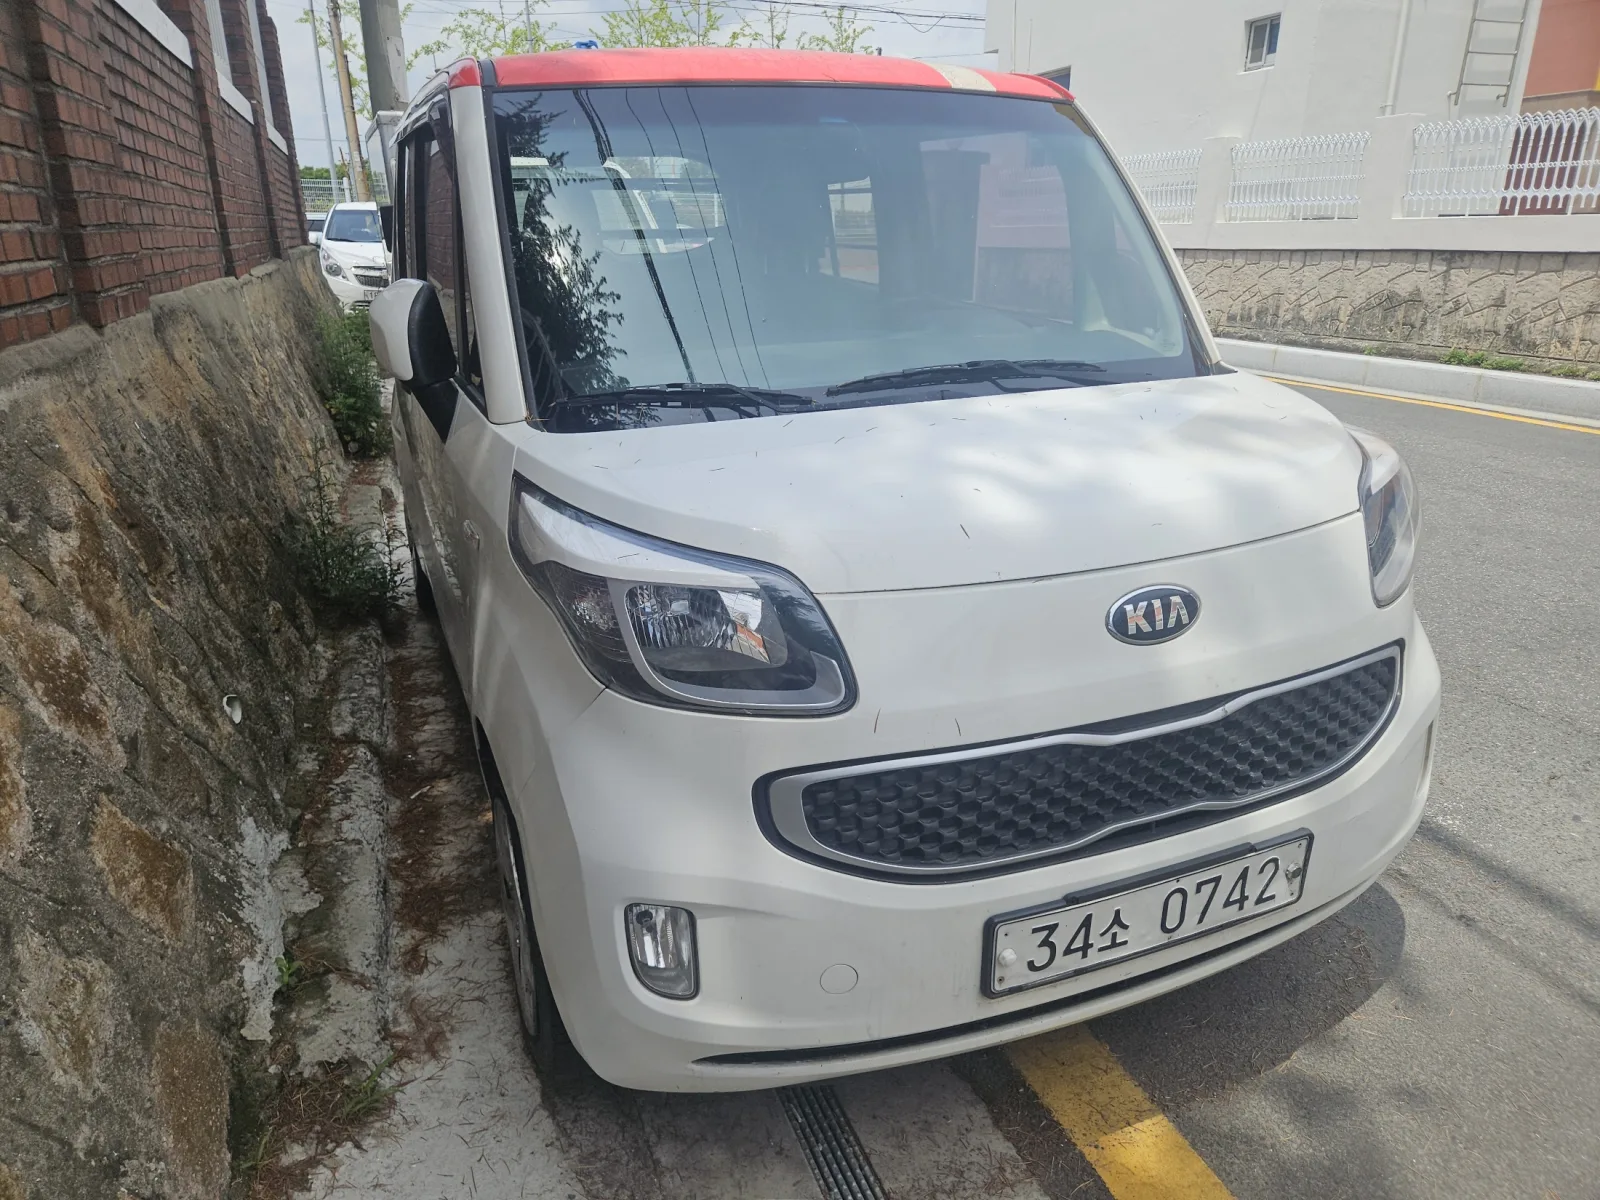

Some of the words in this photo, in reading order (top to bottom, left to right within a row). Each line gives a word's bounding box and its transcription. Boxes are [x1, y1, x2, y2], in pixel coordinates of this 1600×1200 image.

[1123, 595, 1190, 635] KIA
[1026, 908, 1131, 973] 34소
[1159, 855, 1282, 935] 0742
